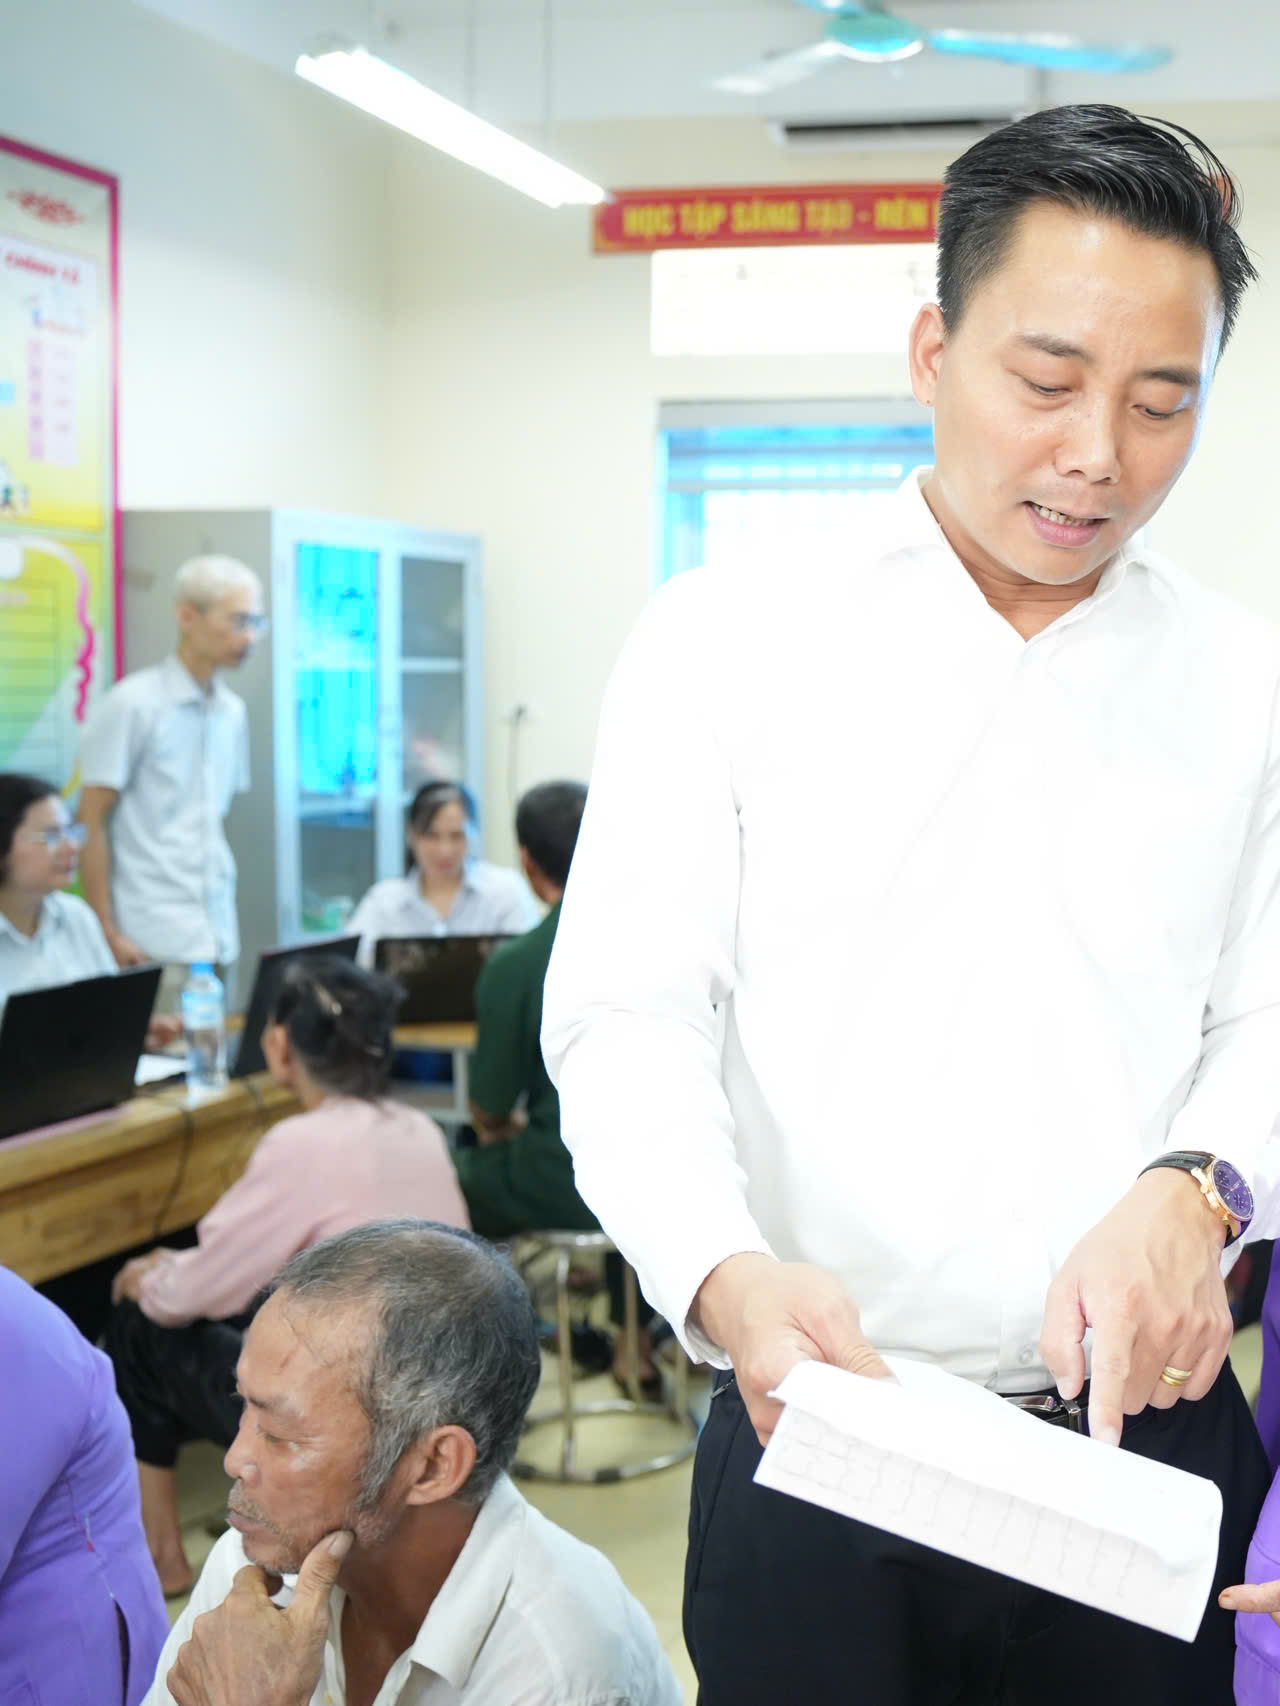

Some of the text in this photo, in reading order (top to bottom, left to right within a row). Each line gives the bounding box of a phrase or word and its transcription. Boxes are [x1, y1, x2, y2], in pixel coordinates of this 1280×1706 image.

[623, 203, 674, 239] HỌC
[731, 196, 800, 232] SÁNG
[806, 199, 852, 236] TẠO
